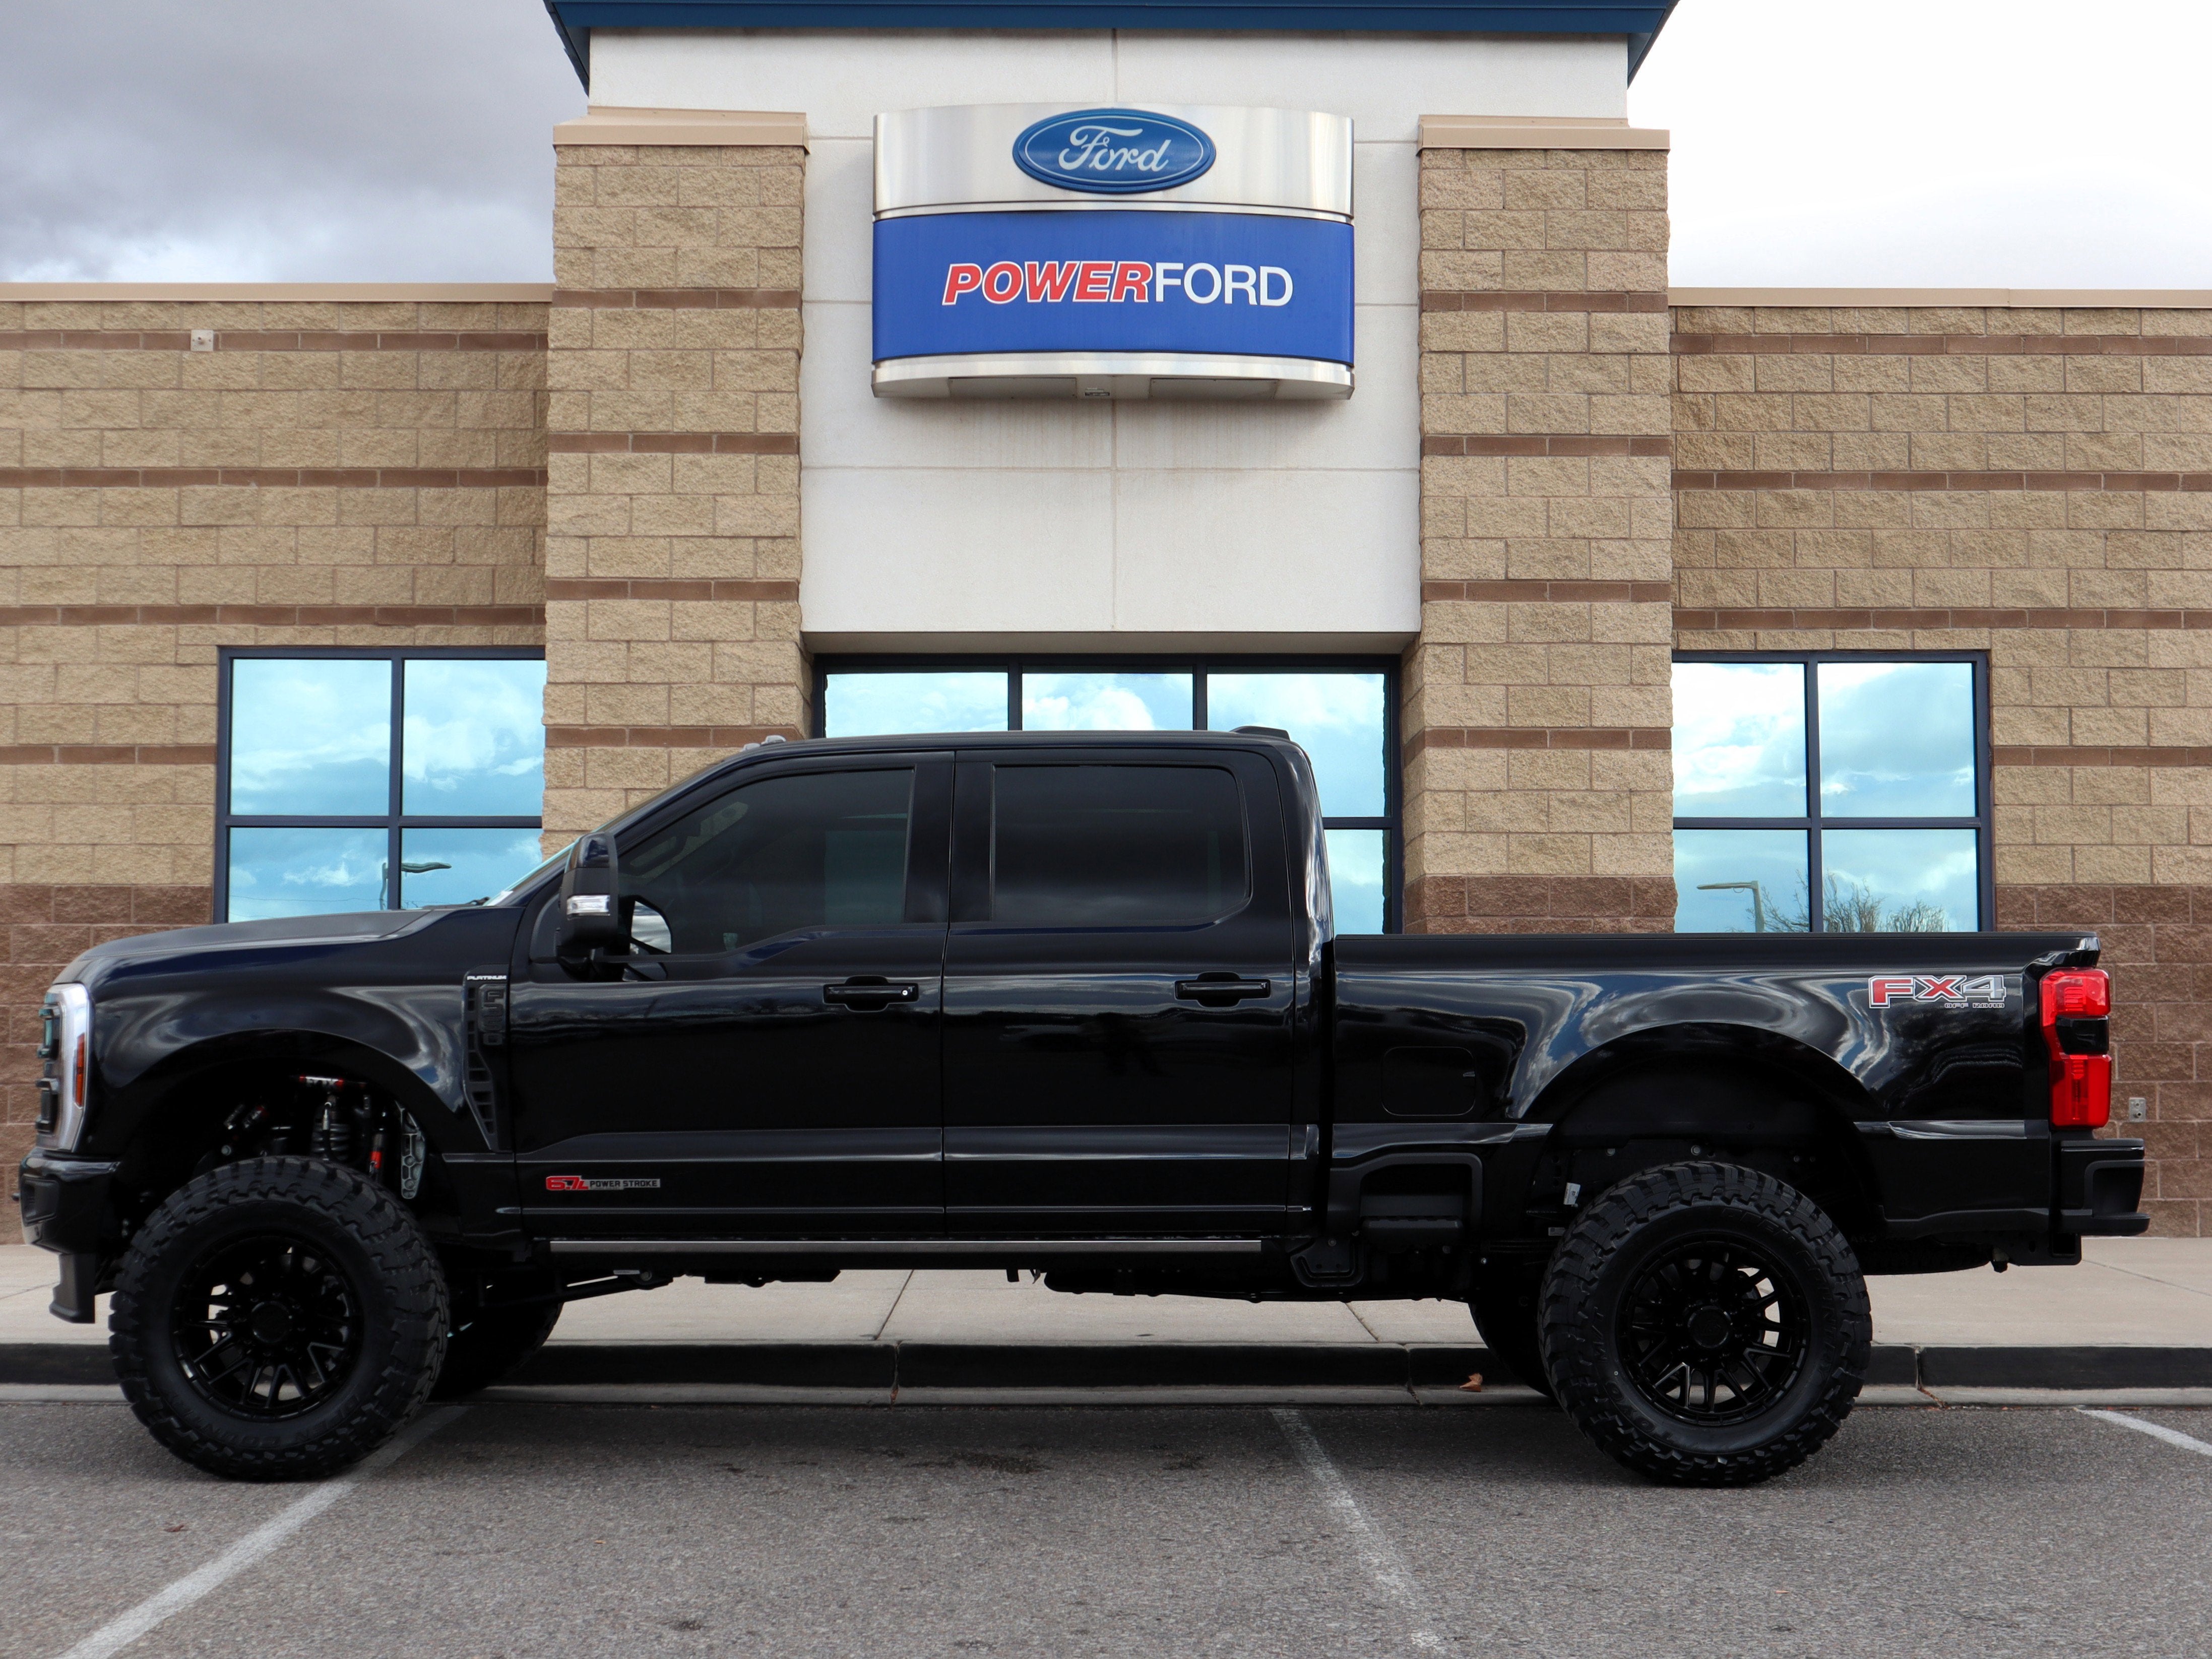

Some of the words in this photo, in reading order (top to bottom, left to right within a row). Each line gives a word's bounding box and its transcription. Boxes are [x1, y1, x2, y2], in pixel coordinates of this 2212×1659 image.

[1058, 125, 1170, 172] Ford
[1869, 975, 2006, 1008] FX4
[546, 1176, 589, 1190] 6.7L
